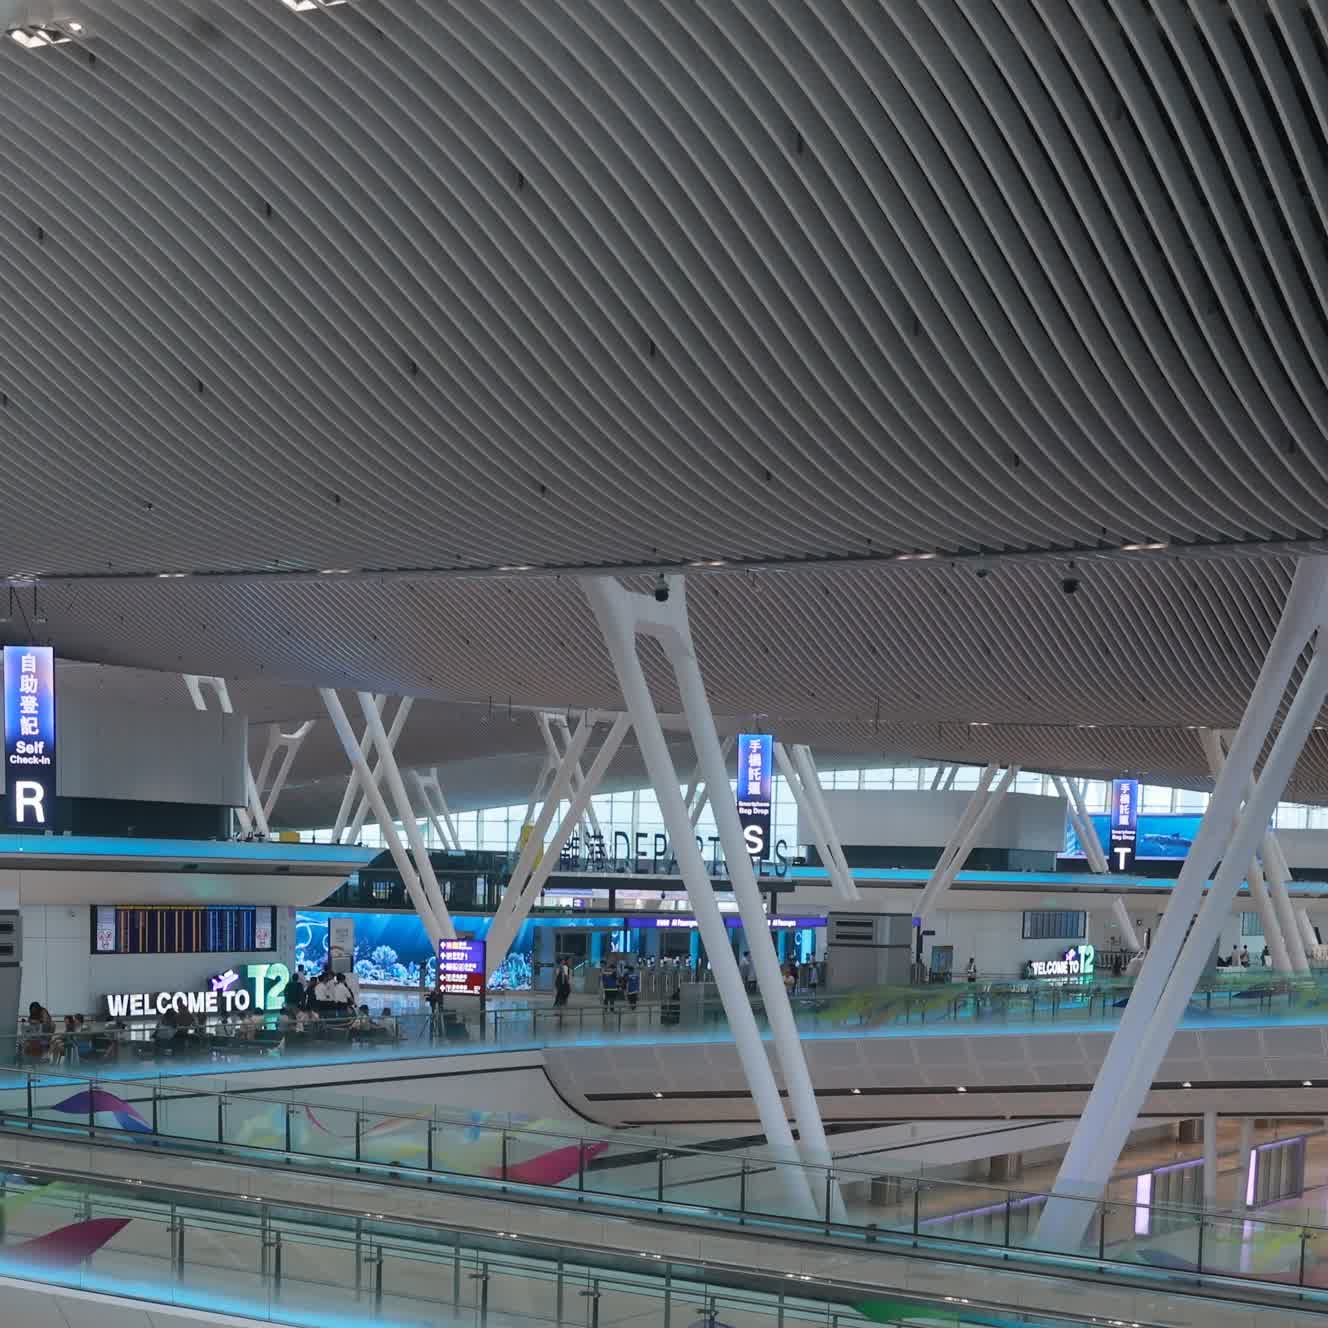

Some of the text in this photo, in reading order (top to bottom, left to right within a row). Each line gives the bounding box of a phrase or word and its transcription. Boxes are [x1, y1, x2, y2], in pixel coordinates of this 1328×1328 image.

[19, 653, 39, 735] 自助登記
[9, 754, 51, 765] Check-in
[16, 740, 44, 755] Self
[15, 780, 45, 823] R
[753, 807, 770, 816] Drop
[743, 824, 764, 854] S
[1113, 847, 1132, 871] T
[1068, 960, 1080, 974] TO
[1078, 944, 1095, 973] T2
[107, 962, 290, 1017] WELCOME TO T2
